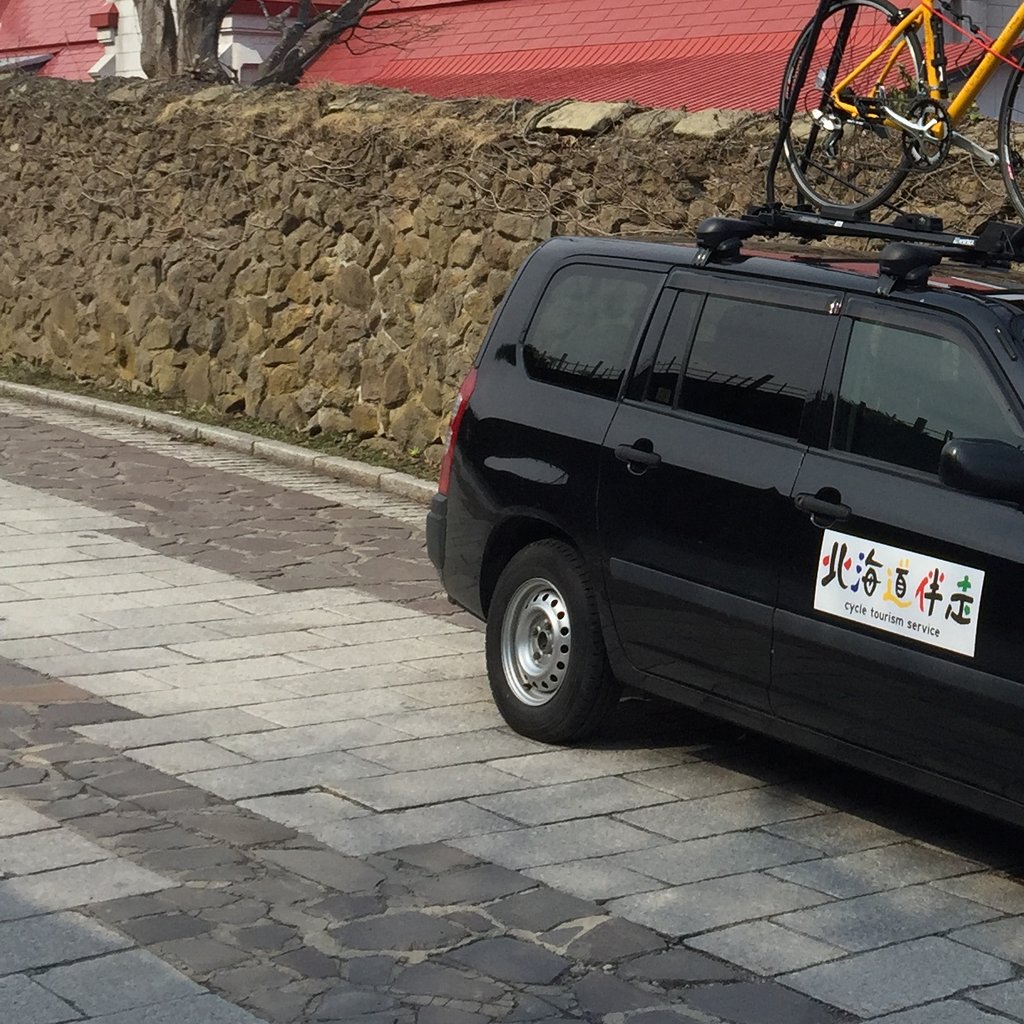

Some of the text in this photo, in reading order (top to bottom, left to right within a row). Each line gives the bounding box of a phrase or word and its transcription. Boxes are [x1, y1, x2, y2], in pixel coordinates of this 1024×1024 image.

[844, 601, 941, 638] cycle tourism service
